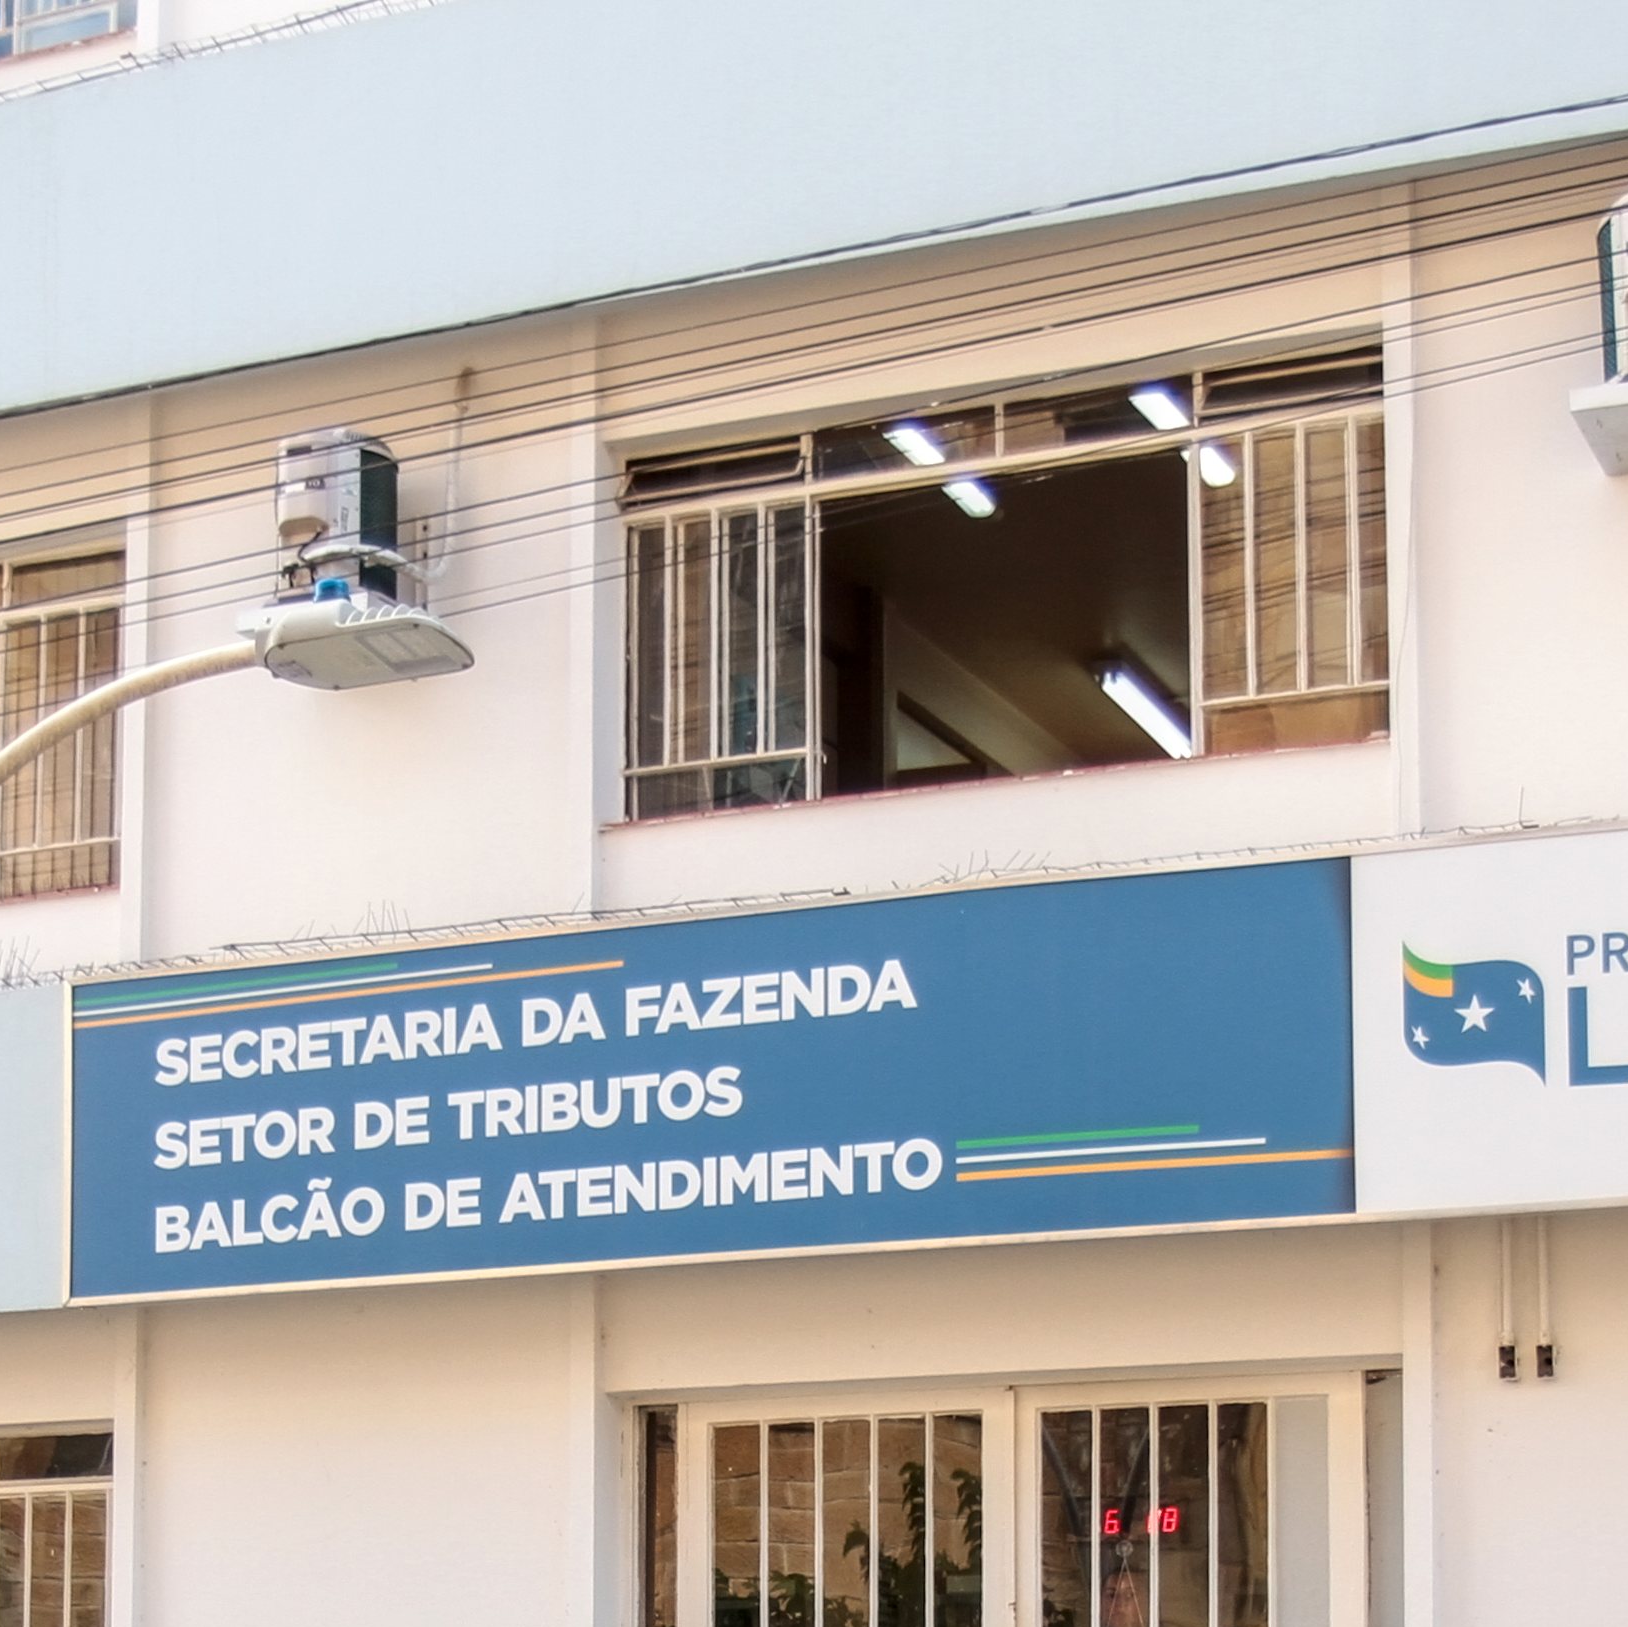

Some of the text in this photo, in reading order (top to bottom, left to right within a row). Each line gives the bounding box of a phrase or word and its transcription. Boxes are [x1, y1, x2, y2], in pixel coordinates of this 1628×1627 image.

[153, 958, 918, 1087] SECRETARIA DA FAZENDA
[153, 1065, 743, 1170] SETOR DE TRIBUTOS
[154, 1137, 943, 1254] BALCÃO DE ATENDIMENTO
